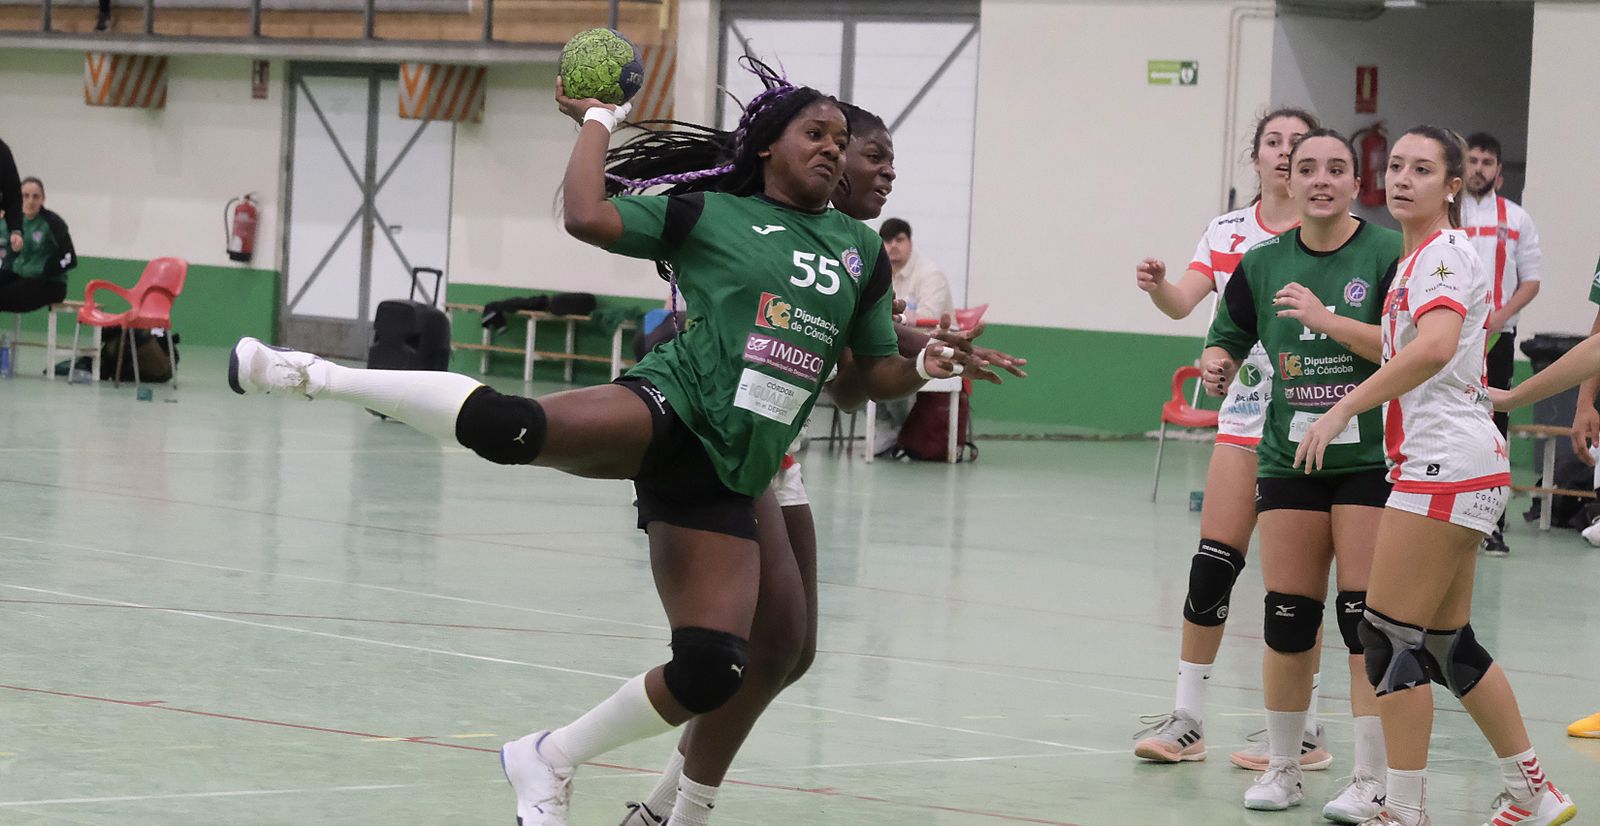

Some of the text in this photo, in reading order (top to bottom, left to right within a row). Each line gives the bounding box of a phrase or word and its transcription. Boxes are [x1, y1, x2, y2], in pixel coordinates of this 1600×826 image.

[1229, 233, 1246, 252] 7
[790, 250, 841, 295] 55
[791, 322, 802, 332] de
[770, 342, 824, 375] IMDECO
[1304, 354, 1353, 368] Diputación
[1304, 364, 1354, 376] de Córdoba
[1296, 383, 1358, 400] IMDECO
